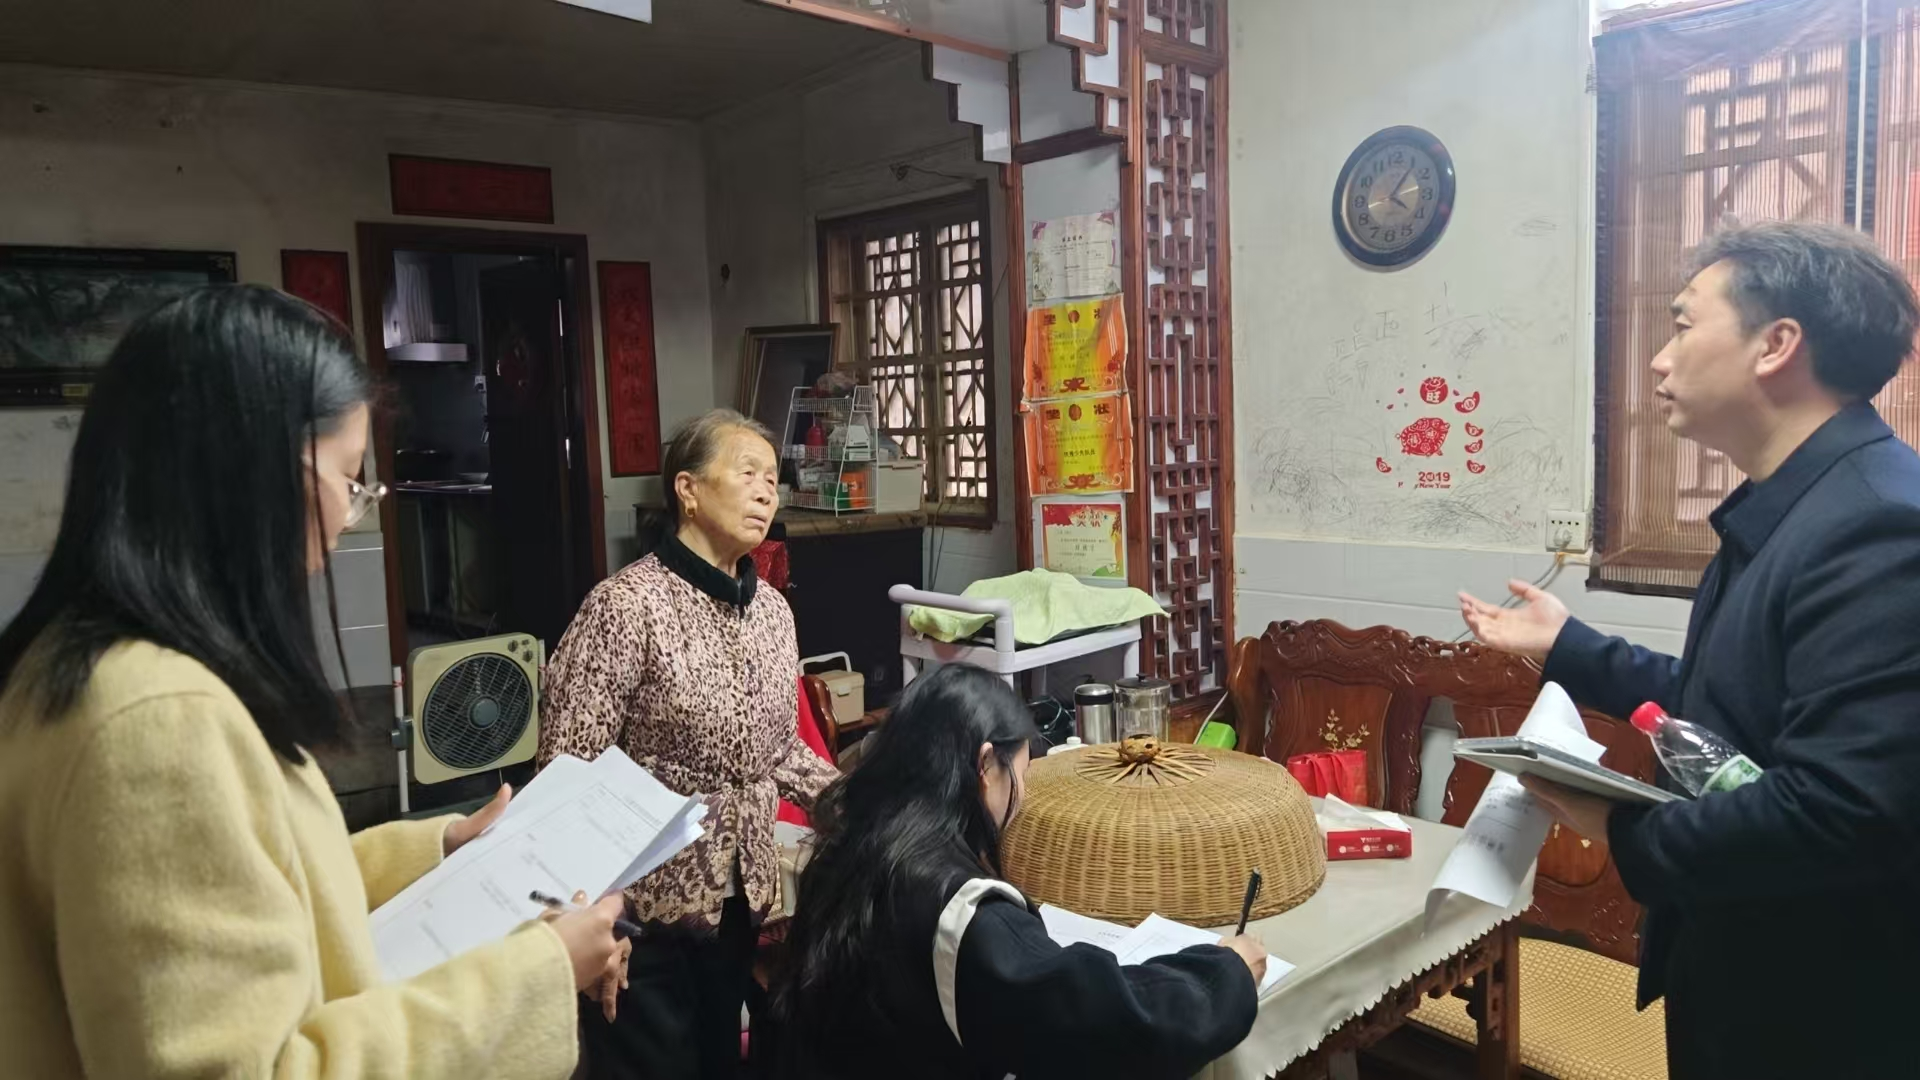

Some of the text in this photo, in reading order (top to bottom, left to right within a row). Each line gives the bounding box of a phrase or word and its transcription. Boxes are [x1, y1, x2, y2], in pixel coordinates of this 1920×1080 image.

[1388, 151, 1403, 166] 12
[1374, 159, 1384, 173] 11
[1419, 168, 1430, 180] 2
[1361, 176, 1372, 188] 10
[1422, 187, 1433, 200] 3
[1354, 195, 1365, 208] 9
[1415, 207, 1424, 219] 4
[1358, 213, 1369, 226] 8
[1370, 226, 1379, 239] 7
[1384, 230, 1395, 242] 6
[1426, 391, 1441, 402] 旺
[1418, 471, 1451, 482] 2019
